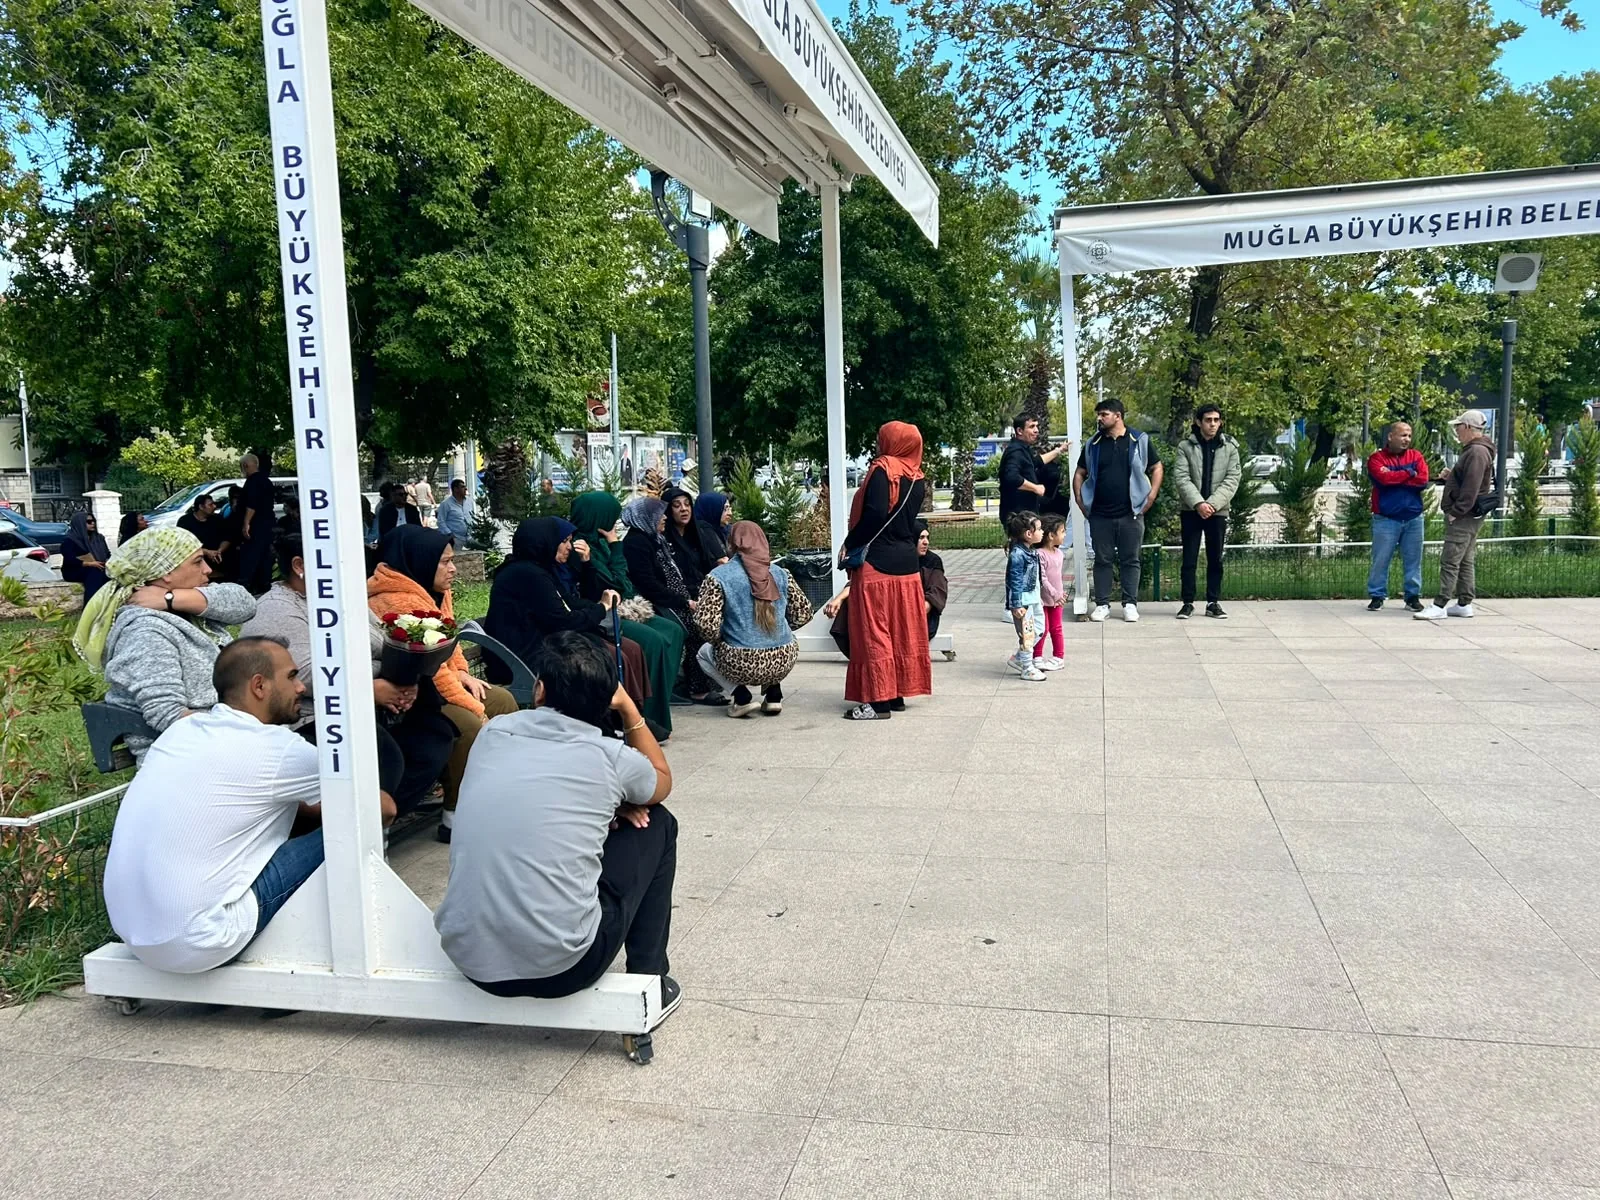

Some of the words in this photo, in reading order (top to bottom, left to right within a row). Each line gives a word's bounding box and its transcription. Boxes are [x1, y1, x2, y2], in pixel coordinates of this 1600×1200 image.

[271, 0, 299, 103] ĞLA
[794, 13, 863, 138] BÜYÜKŞEHİR
[865, 112, 907, 192] BELEDİYESİ
[283, 145, 325, 449] BÜYÜKŞEHİR
[1223, 221, 1320, 251] MUĞLA
[1328, 204, 1513, 243] BÜYÜKŞEHİR
[309, 489, 343, 772] BELEDİYESİ
